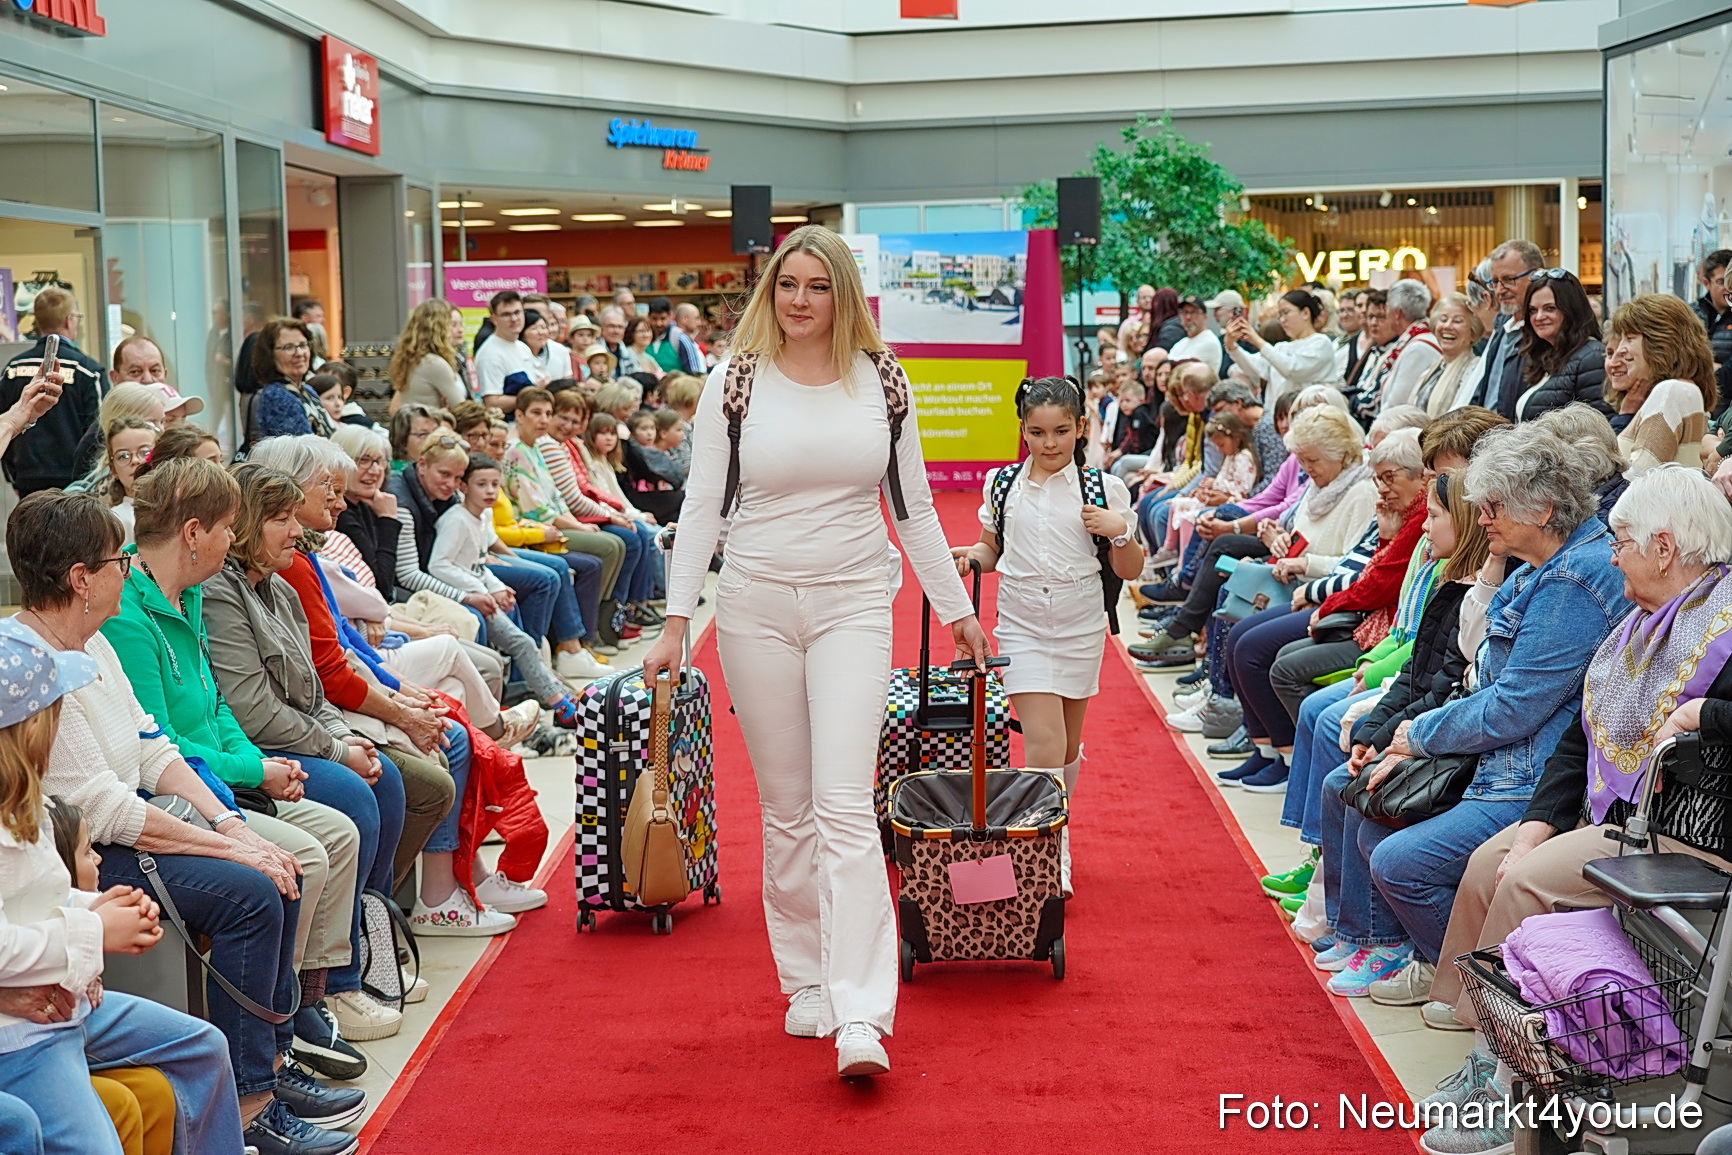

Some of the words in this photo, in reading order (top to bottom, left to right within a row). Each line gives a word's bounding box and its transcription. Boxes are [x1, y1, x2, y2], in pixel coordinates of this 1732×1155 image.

[608, 118, 698, 149] Spielwaren
[663, 149, 711, 171] Krömer
[1296, 246, 1427, 282] VERO
[450, 277, 519, 291] Verschenken
[519, 276, 538, 289] Sie
